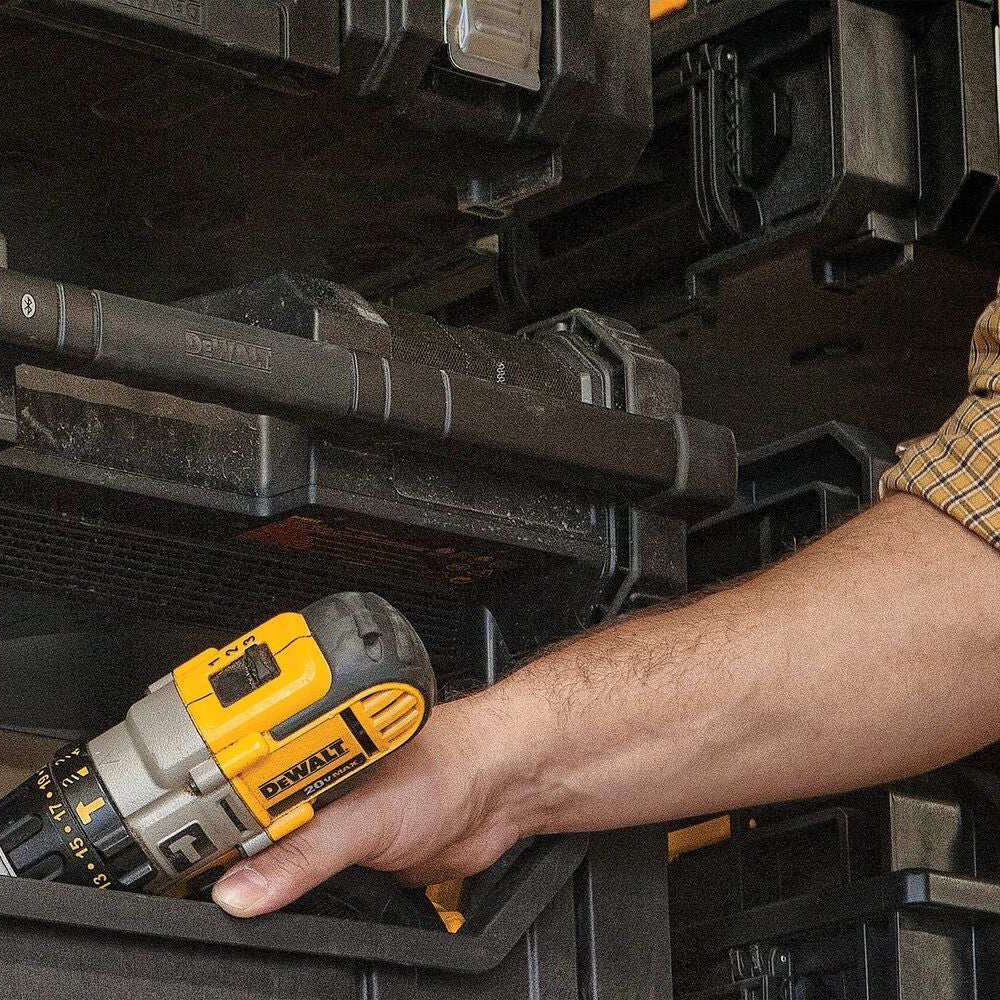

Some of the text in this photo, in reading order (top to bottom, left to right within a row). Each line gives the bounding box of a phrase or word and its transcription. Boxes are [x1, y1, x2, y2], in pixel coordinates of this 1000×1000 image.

[258, 740, 348, 799] DEWALT
[332, 760, 359, 777] MAX
[37, 774, 51, 789] 19
[49, 803, 66, 821] 17
[69, 837, 88, 858] 15
